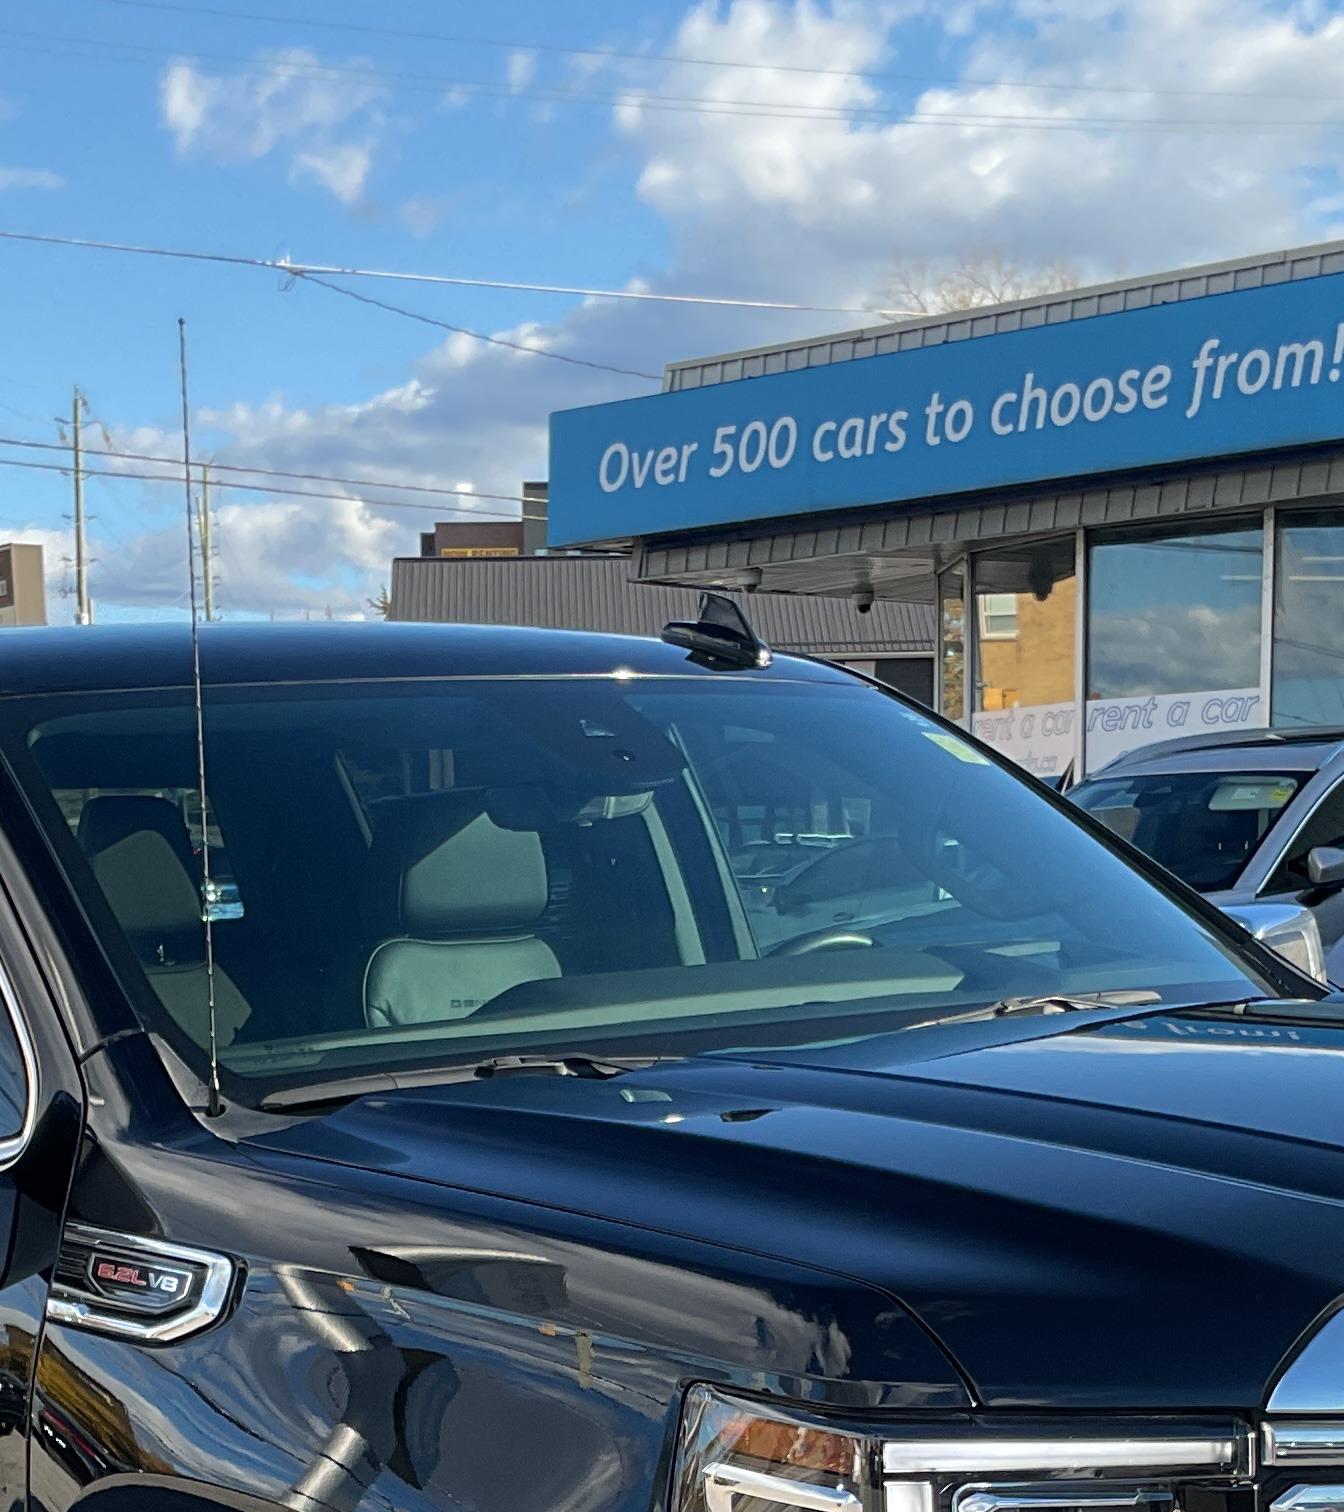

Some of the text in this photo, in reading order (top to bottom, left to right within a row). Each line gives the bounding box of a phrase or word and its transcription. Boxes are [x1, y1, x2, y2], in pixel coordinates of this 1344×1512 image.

[599, 441, 698, 494] Over
[709, 415, 797, 479] 500
[812, 406, 909, 461] cars
[925, 393, 974, 447] to
[991, 363, 1172, 437] choose
[1087, 696, 1260, 732] rent a car
[148, 1272, 180, 1293] V8
